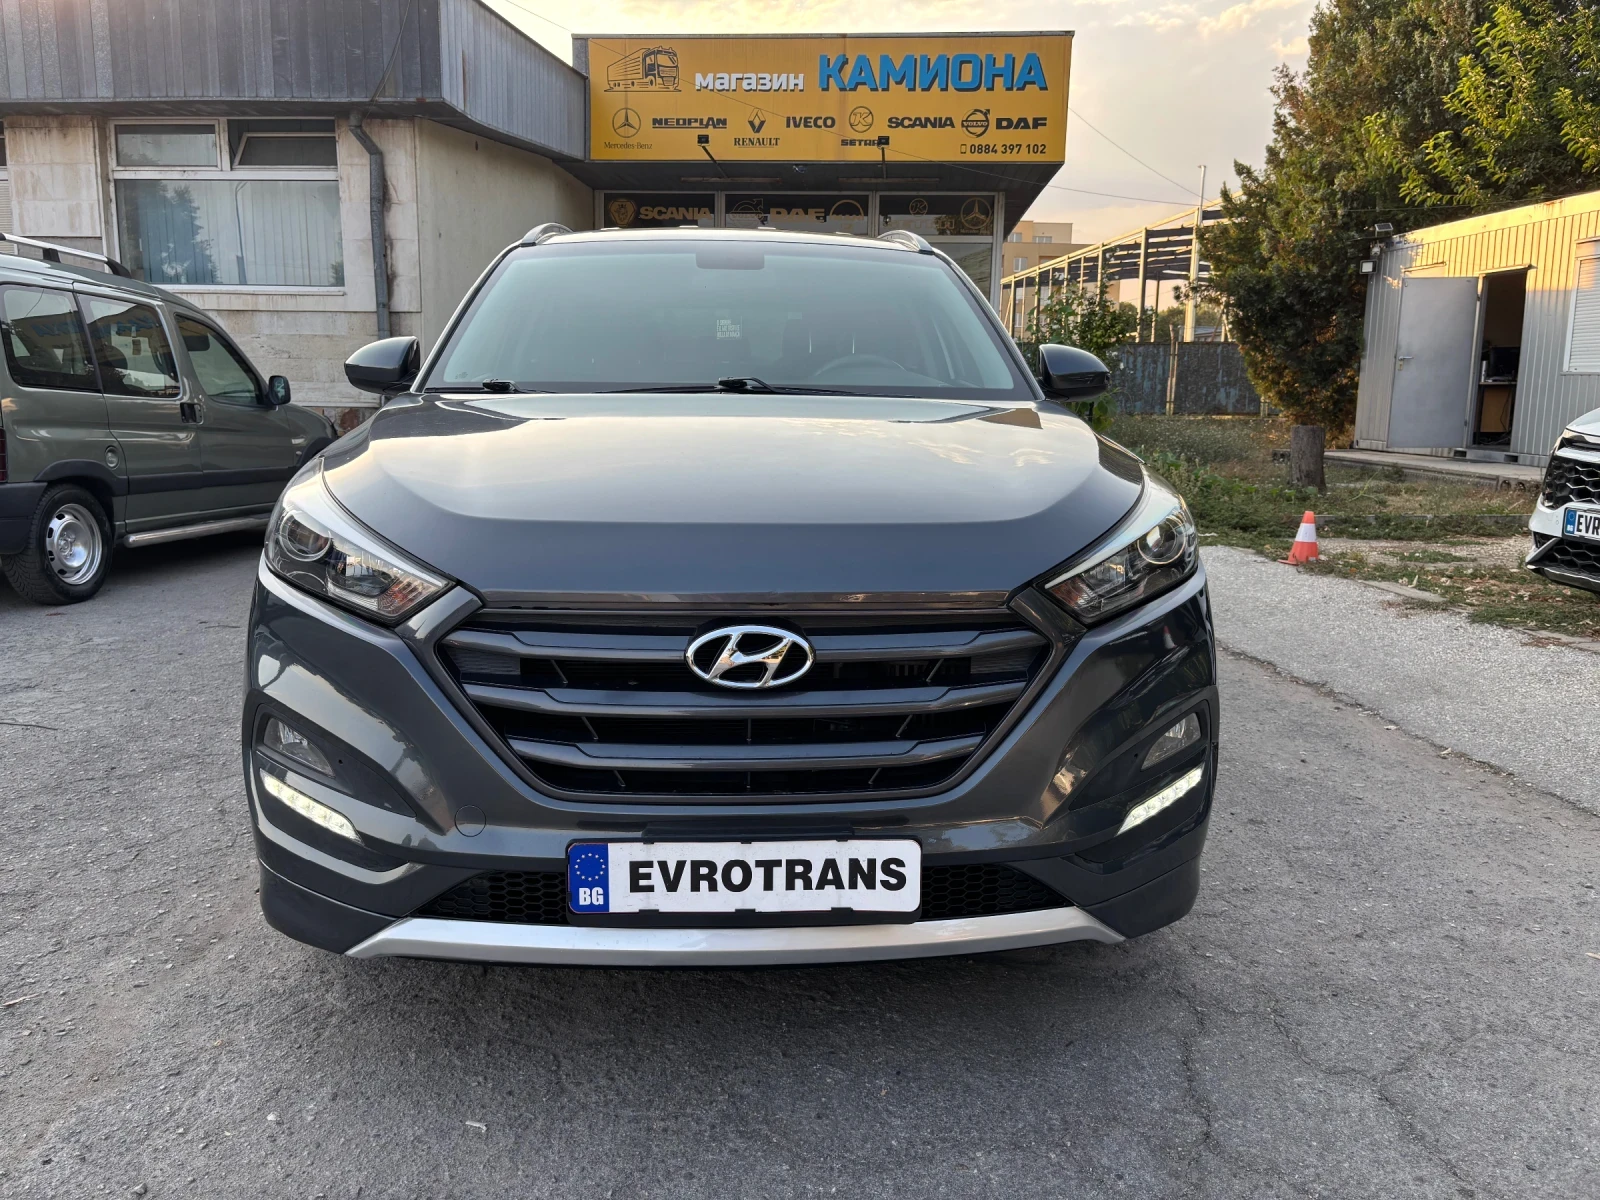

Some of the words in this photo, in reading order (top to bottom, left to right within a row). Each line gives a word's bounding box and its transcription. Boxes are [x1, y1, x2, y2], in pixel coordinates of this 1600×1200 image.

[695, 72, 804, 92] магазин
[818, 52, 1049, 92] КАМИОНА
[652, 117, 727, 129] NEOPLAN
[786, 116, 836, 128] IVECO
[887, 116, 956, 129] SCANIA
[996, 117, 1047, 130] DAF
[604, 141, 653, 150] Mercedes-Benz
[734, 137, 780, 147] RENAULT
[969, 144, 998, 154] 0884
[1001, 144, 1022, 154] 397
[1026, 144, 1047, 154] 102
[639, 207, 713, 220] SCANIA
[579, 887, 604, 905] BG
[629, 858, 907, 893] EVROTRANS
